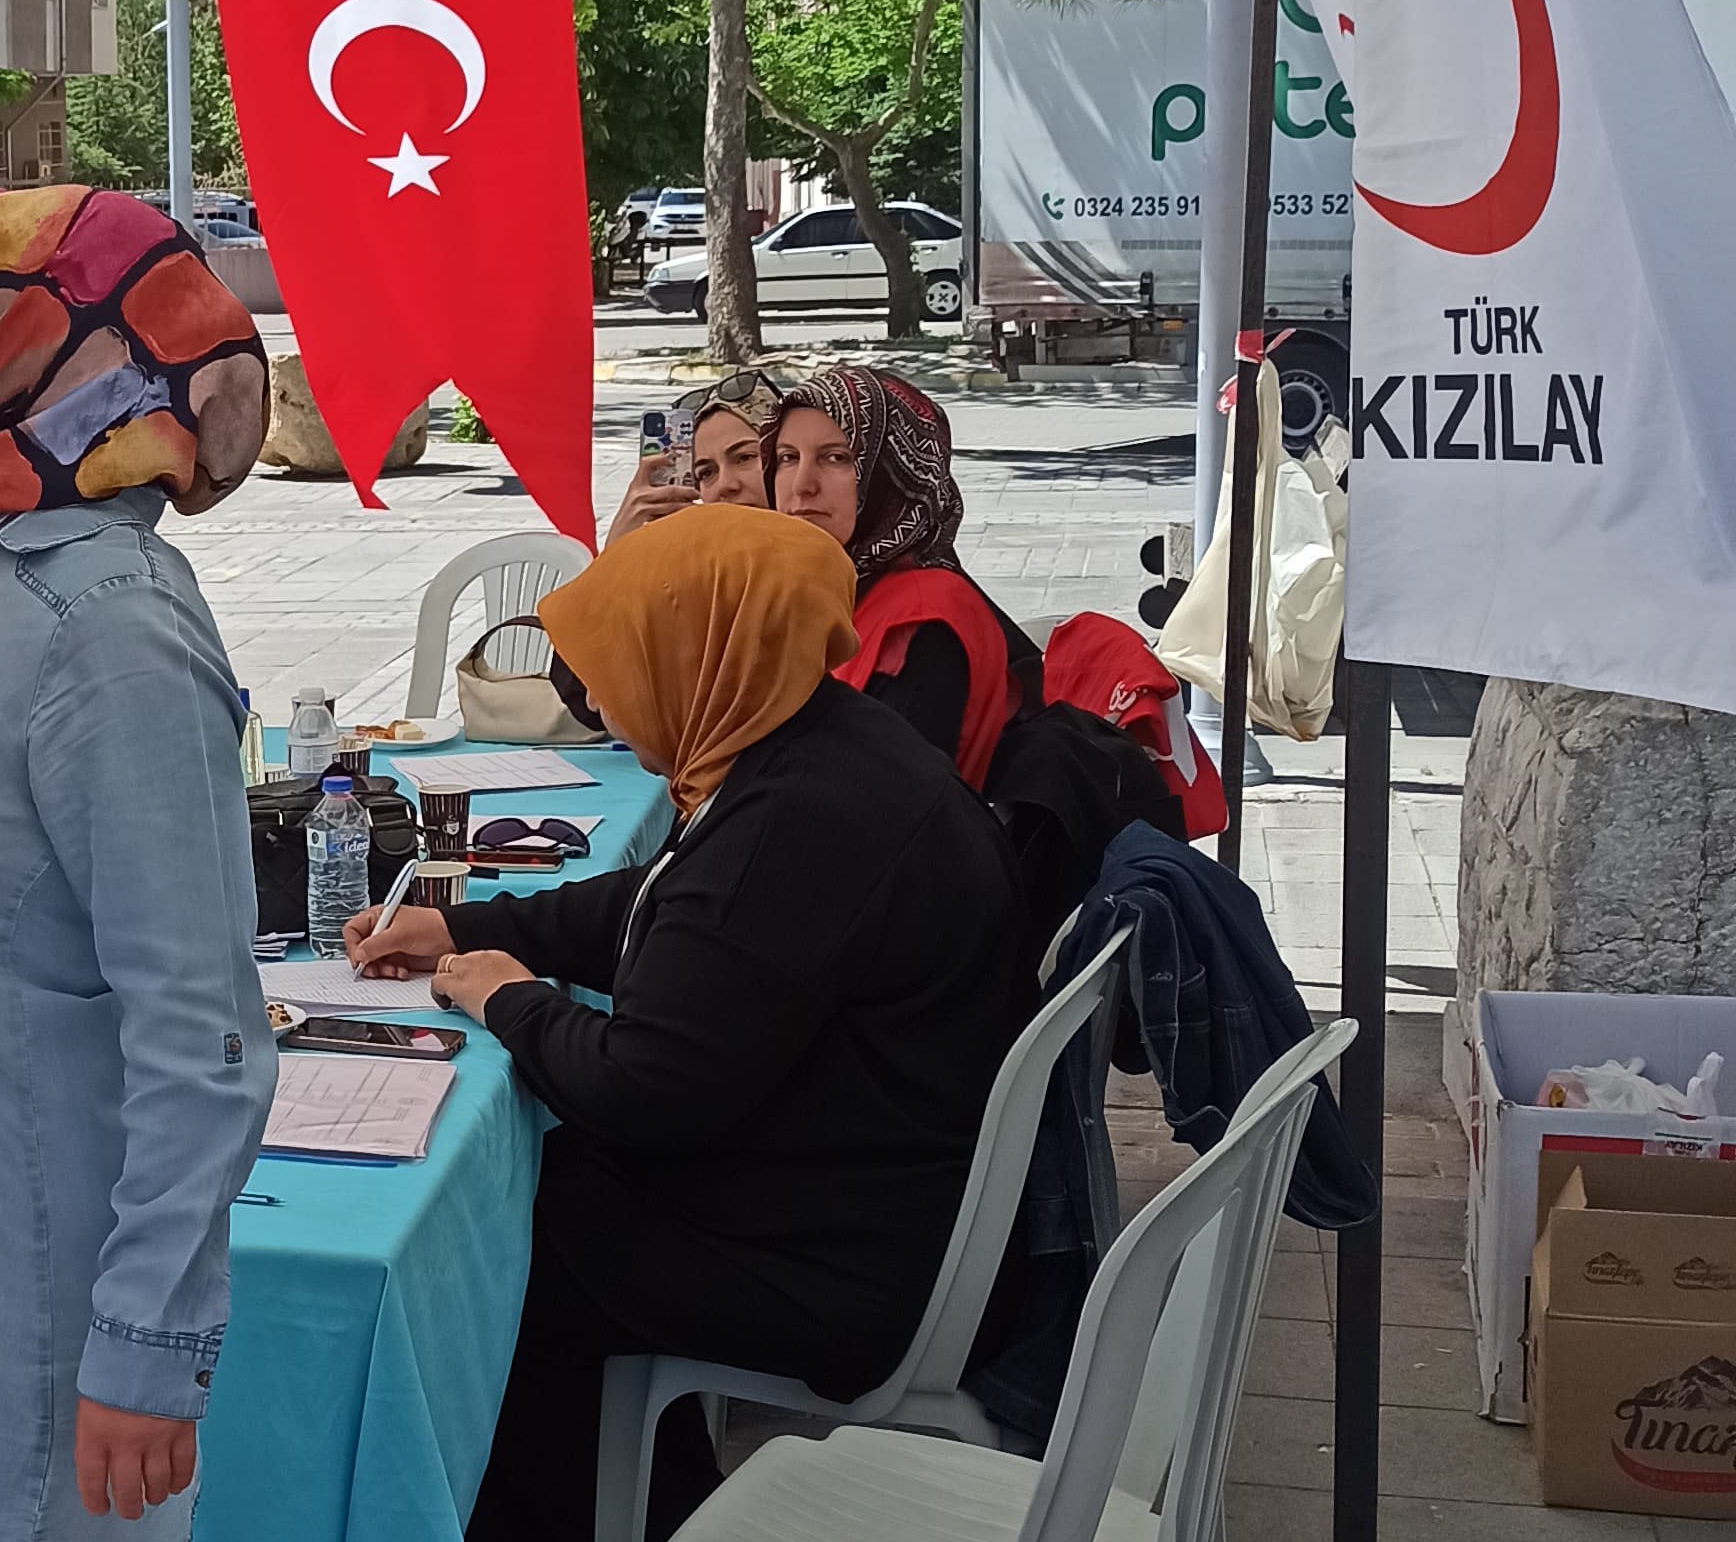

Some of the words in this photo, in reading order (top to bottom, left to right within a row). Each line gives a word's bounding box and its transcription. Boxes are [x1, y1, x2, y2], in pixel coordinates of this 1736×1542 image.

[1074, 196, 1124, 217] 0324
[1131, 196, 1169, 217] 235
[1267, 194, 1313, 215] 533
[1444, 296, 1543, 355] TÜRK
[1352, 374, 1604, 465] KIZILAY
